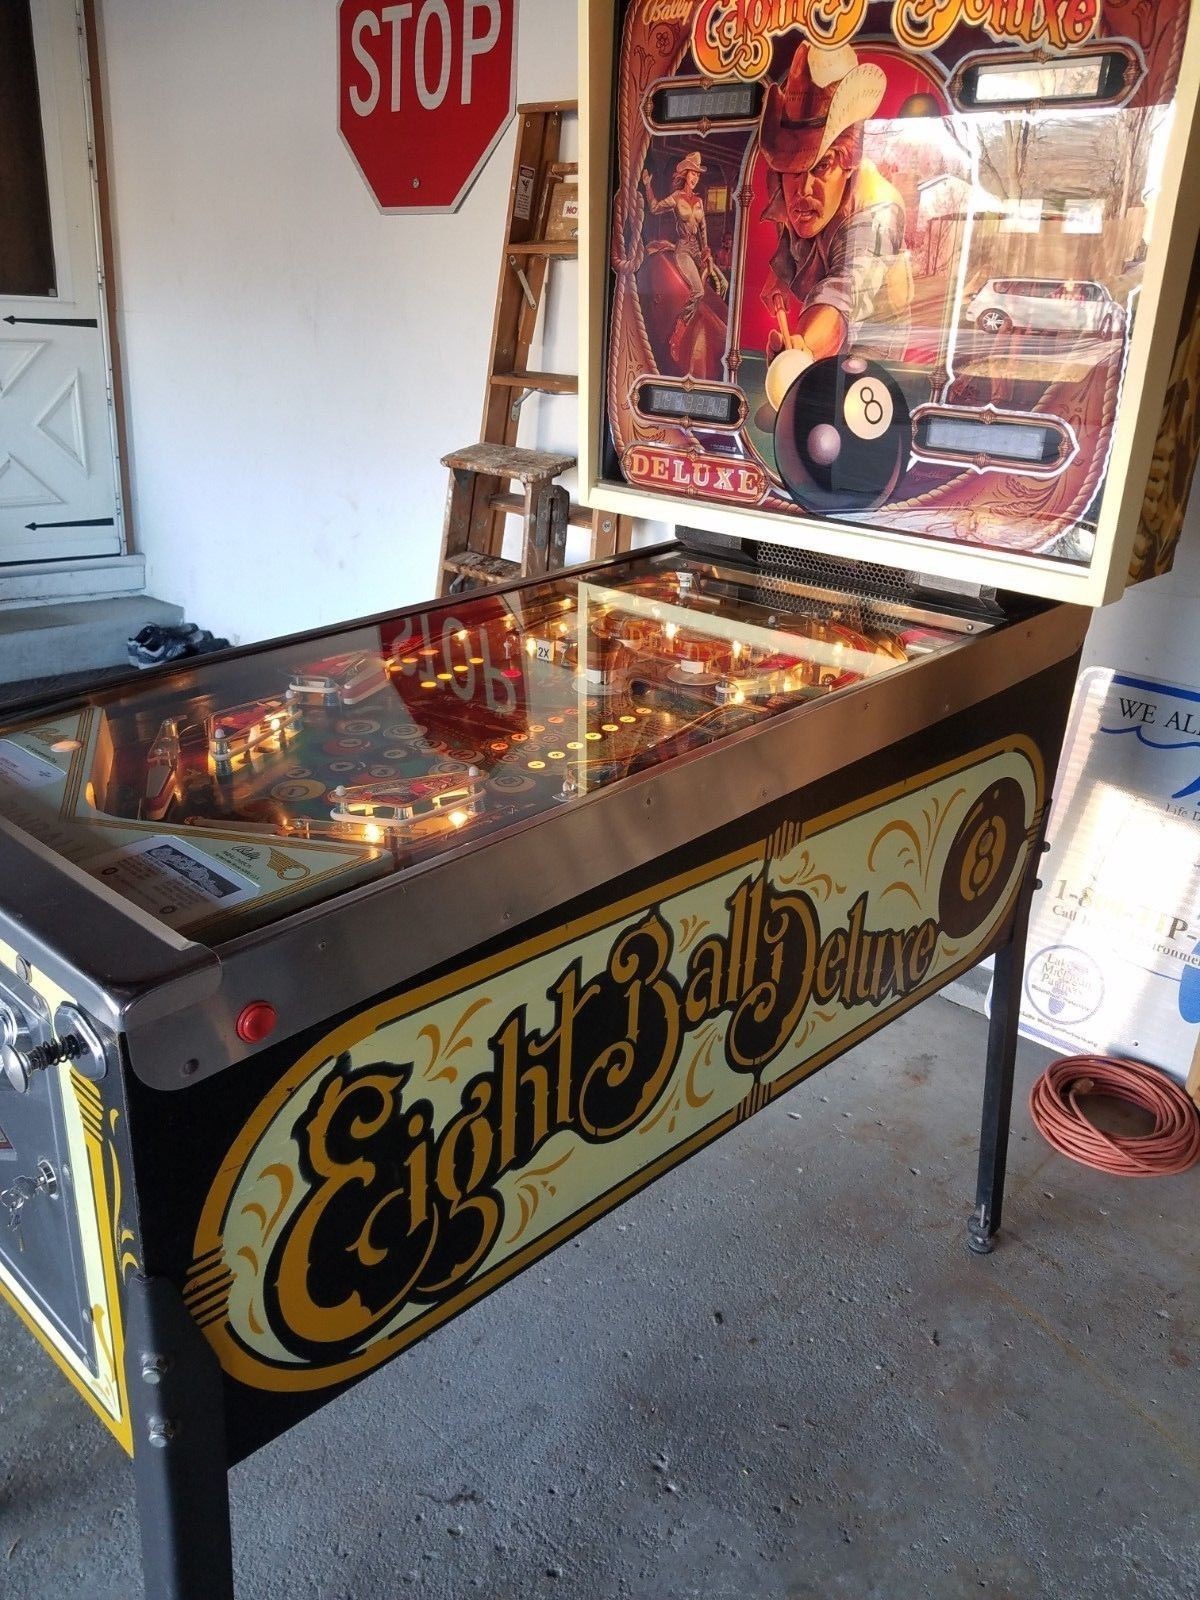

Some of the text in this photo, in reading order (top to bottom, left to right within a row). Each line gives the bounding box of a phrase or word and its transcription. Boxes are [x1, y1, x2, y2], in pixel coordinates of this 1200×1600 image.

[349, 0, 502, 117] STOP
[860, 386, 883, 425] 8
[631, 453, 759, 496] DELUXE
[538, 646, 550, 660] 2X
[1119, 697, 1200, 736] WE AL
[1052, 904, 1078, 922] Call
[272, 877, 938, 1344] Eight Ball Deluxe
